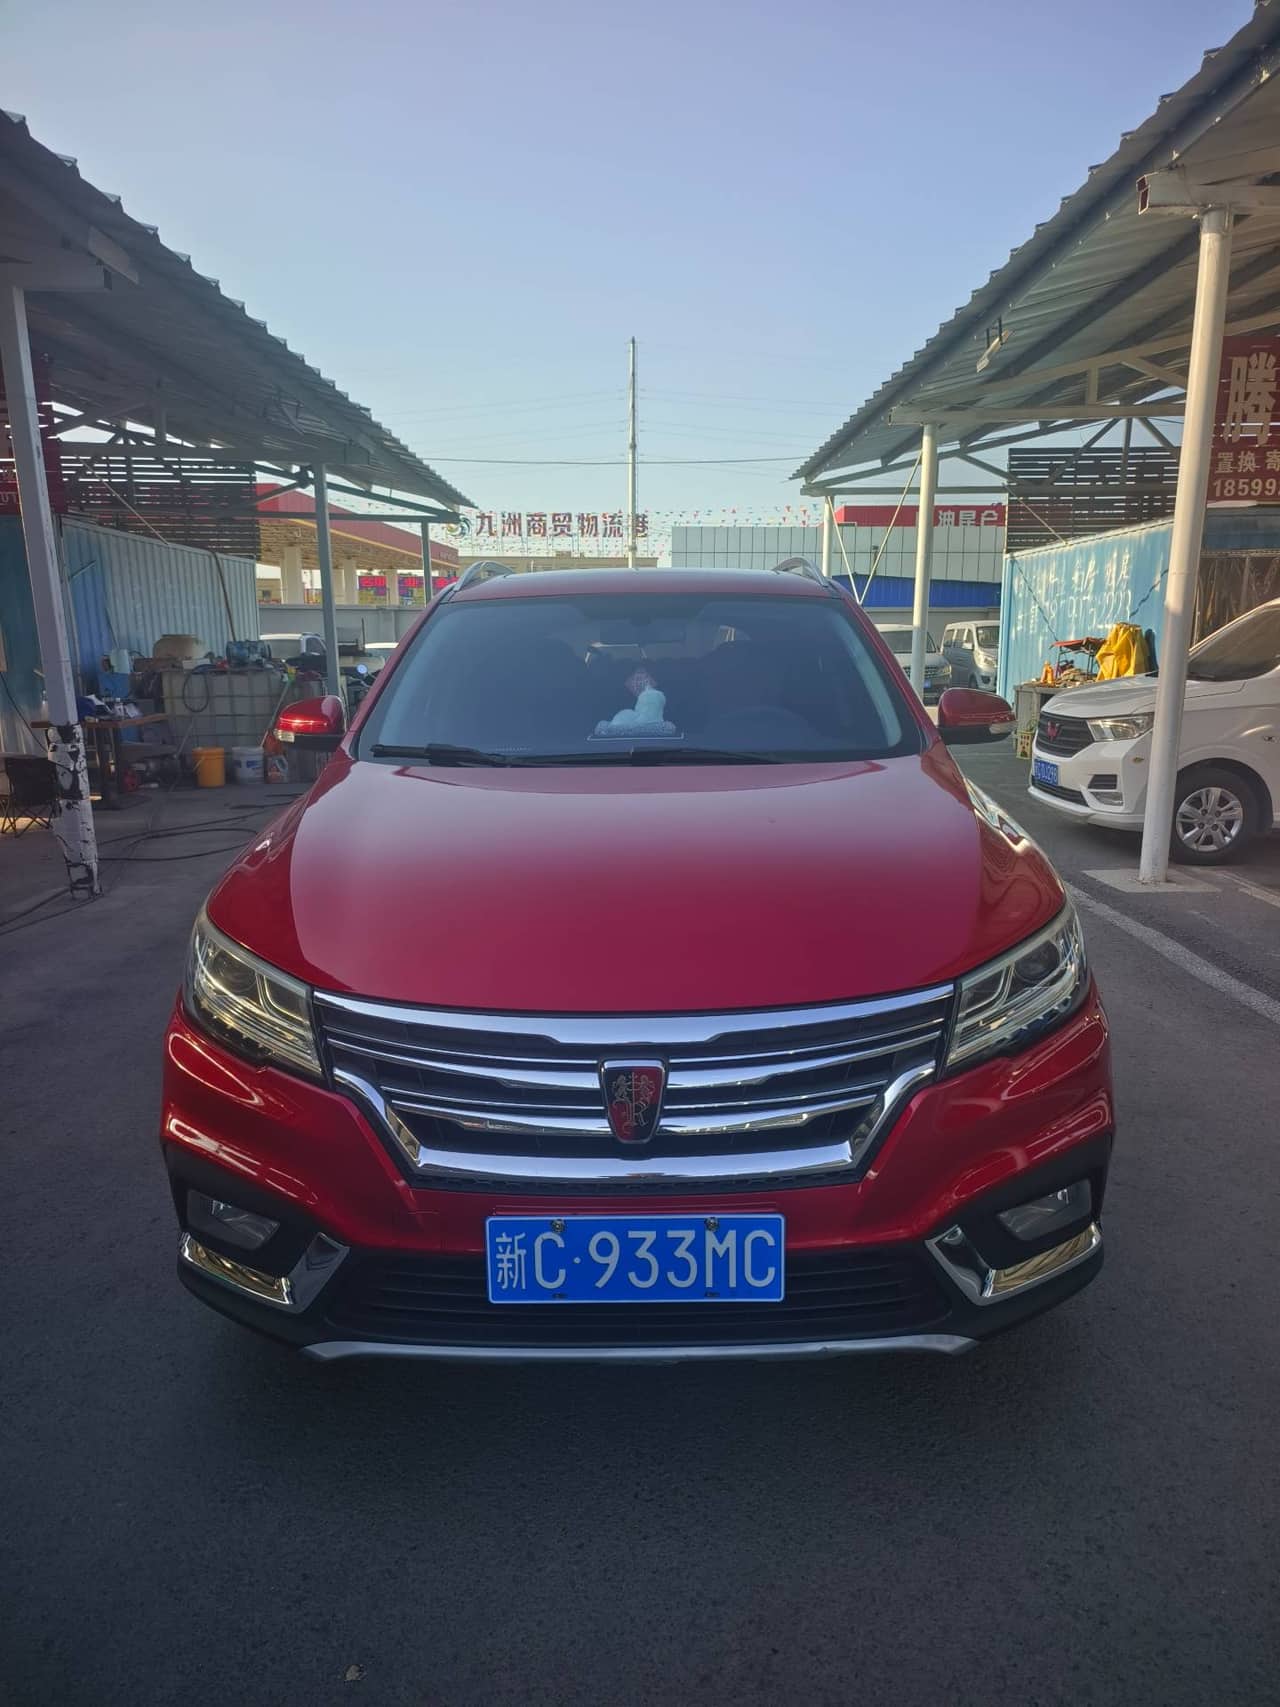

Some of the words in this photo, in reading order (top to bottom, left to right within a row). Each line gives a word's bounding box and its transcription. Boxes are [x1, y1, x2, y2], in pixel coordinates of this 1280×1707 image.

[1215, 450, 1256, 473] 置换
[1213, 478, 1280, 497] 18599
[476, 512, 649, 539] 九洲商贸物流港
[495, 1229, 776, 1290] 新C·933MC
